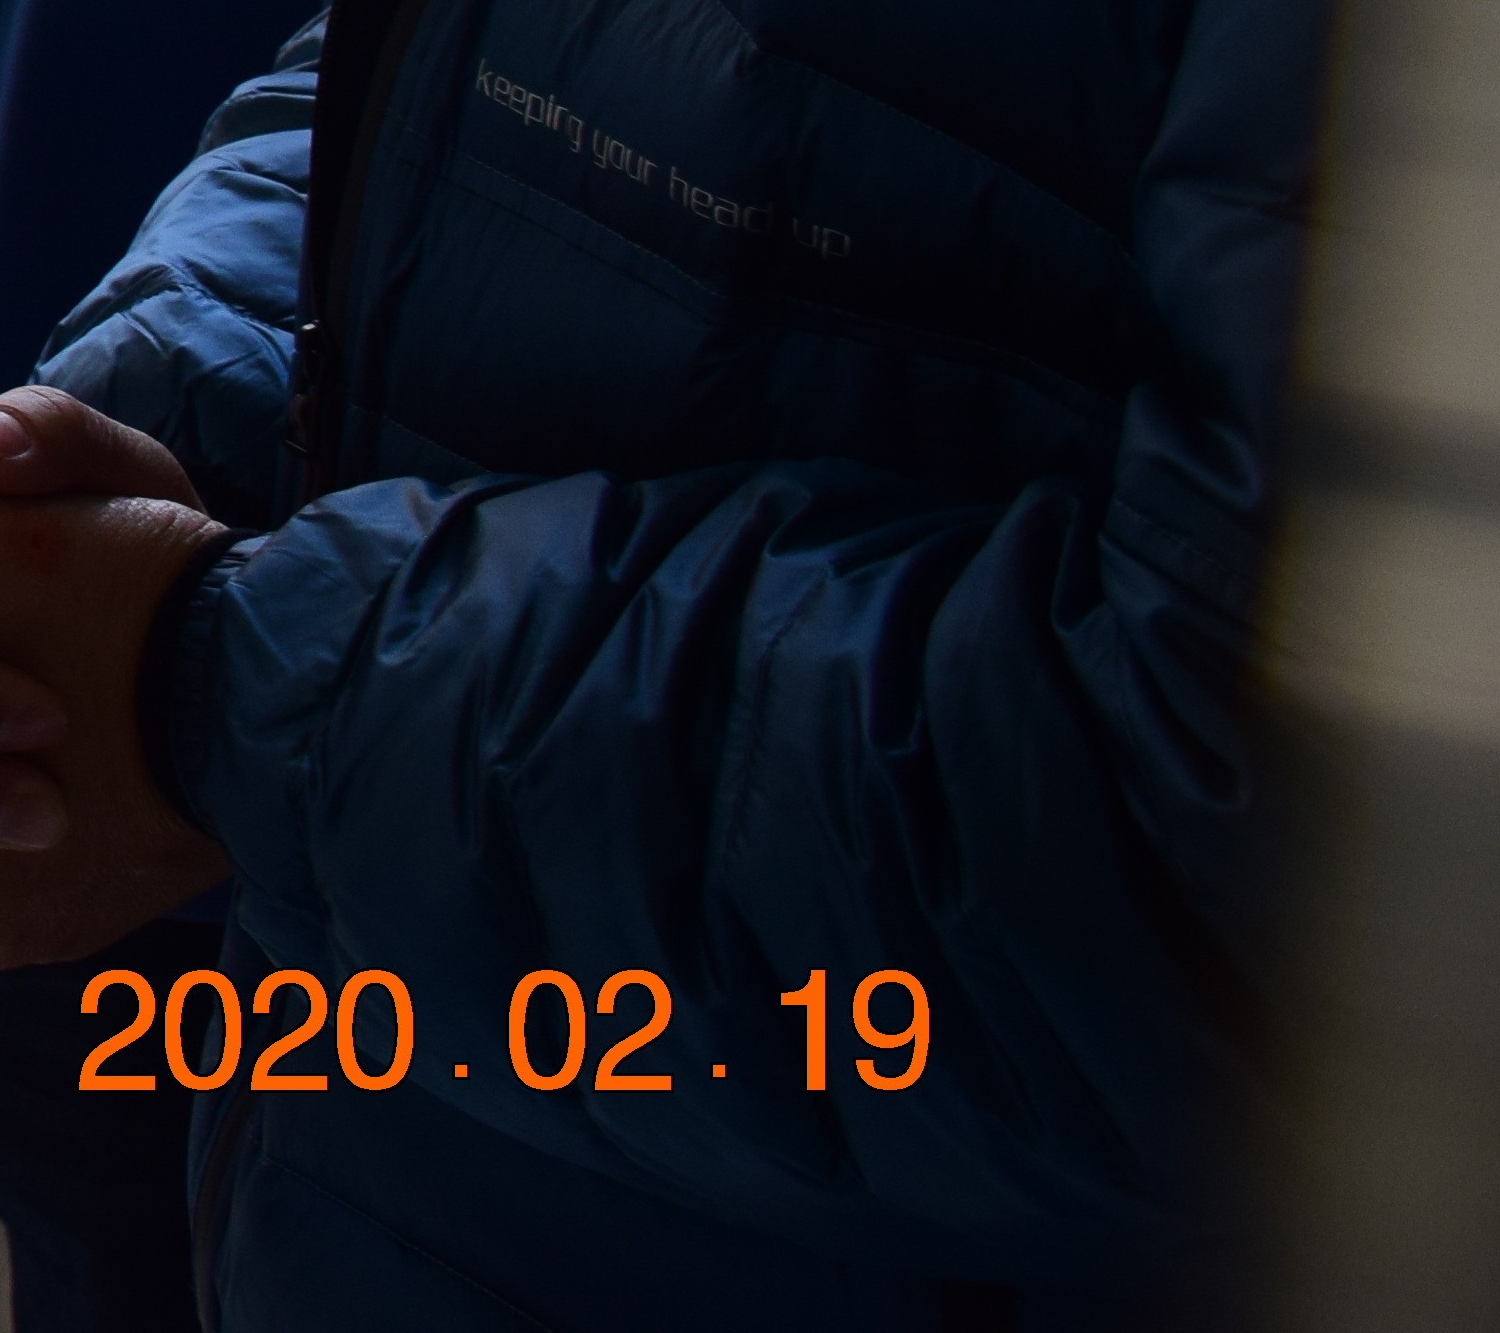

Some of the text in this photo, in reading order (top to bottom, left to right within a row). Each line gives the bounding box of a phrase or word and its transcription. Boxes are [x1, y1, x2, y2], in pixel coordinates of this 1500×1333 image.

[592, 128, 658, 185] your
[668, 166, 776, 234] head
[791, 217, 853, 260] up
